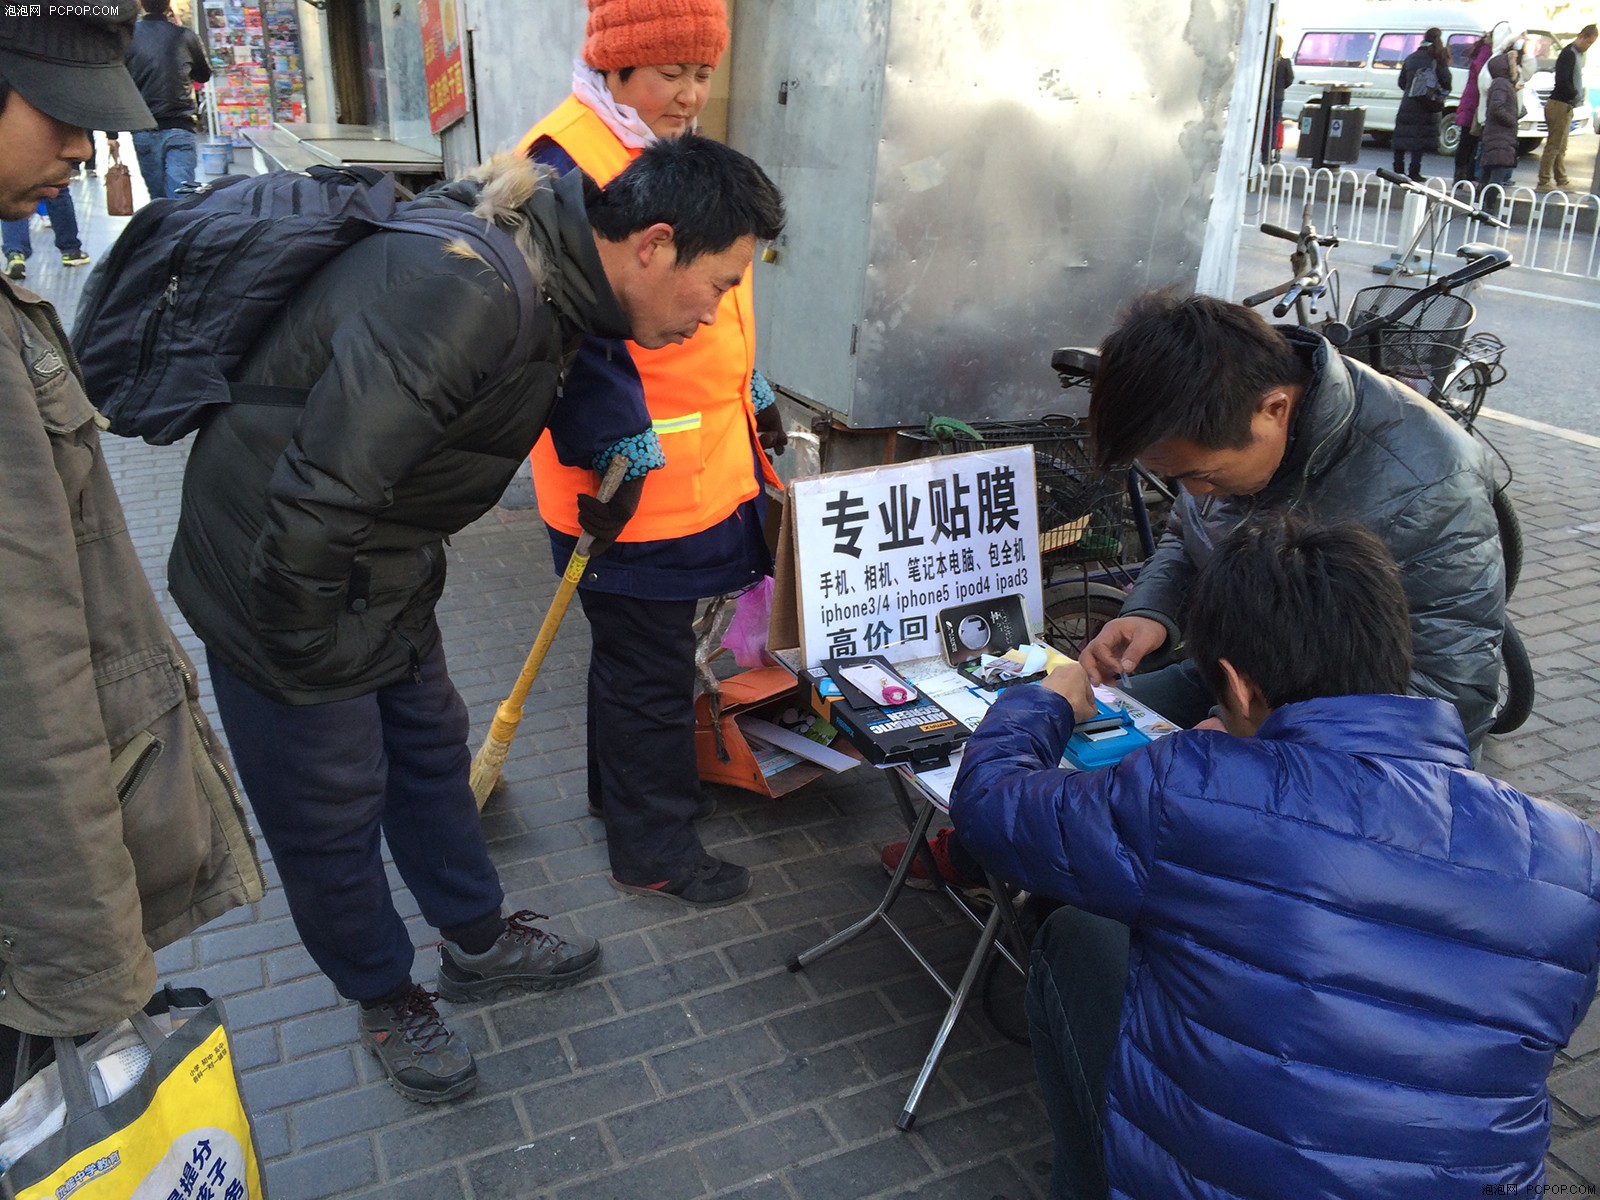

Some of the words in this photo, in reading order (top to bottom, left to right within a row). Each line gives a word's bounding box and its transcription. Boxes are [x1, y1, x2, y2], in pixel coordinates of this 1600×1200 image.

[822, 465, 1020, 559] 专业贴膜
[820, 537, 1026, 599] 手机、相机、笔记本电脑、包全机
[821, 594, 890, 627] iphone3/4
[897, 575, 950, 613] iphone5
[955, 575, 991, 602] ipod4
[996, 567, 1029, 594] ipad3
[869, 711, 949, 735] AUTOMATIC
[886, 705, 940, 721] SCREEN
